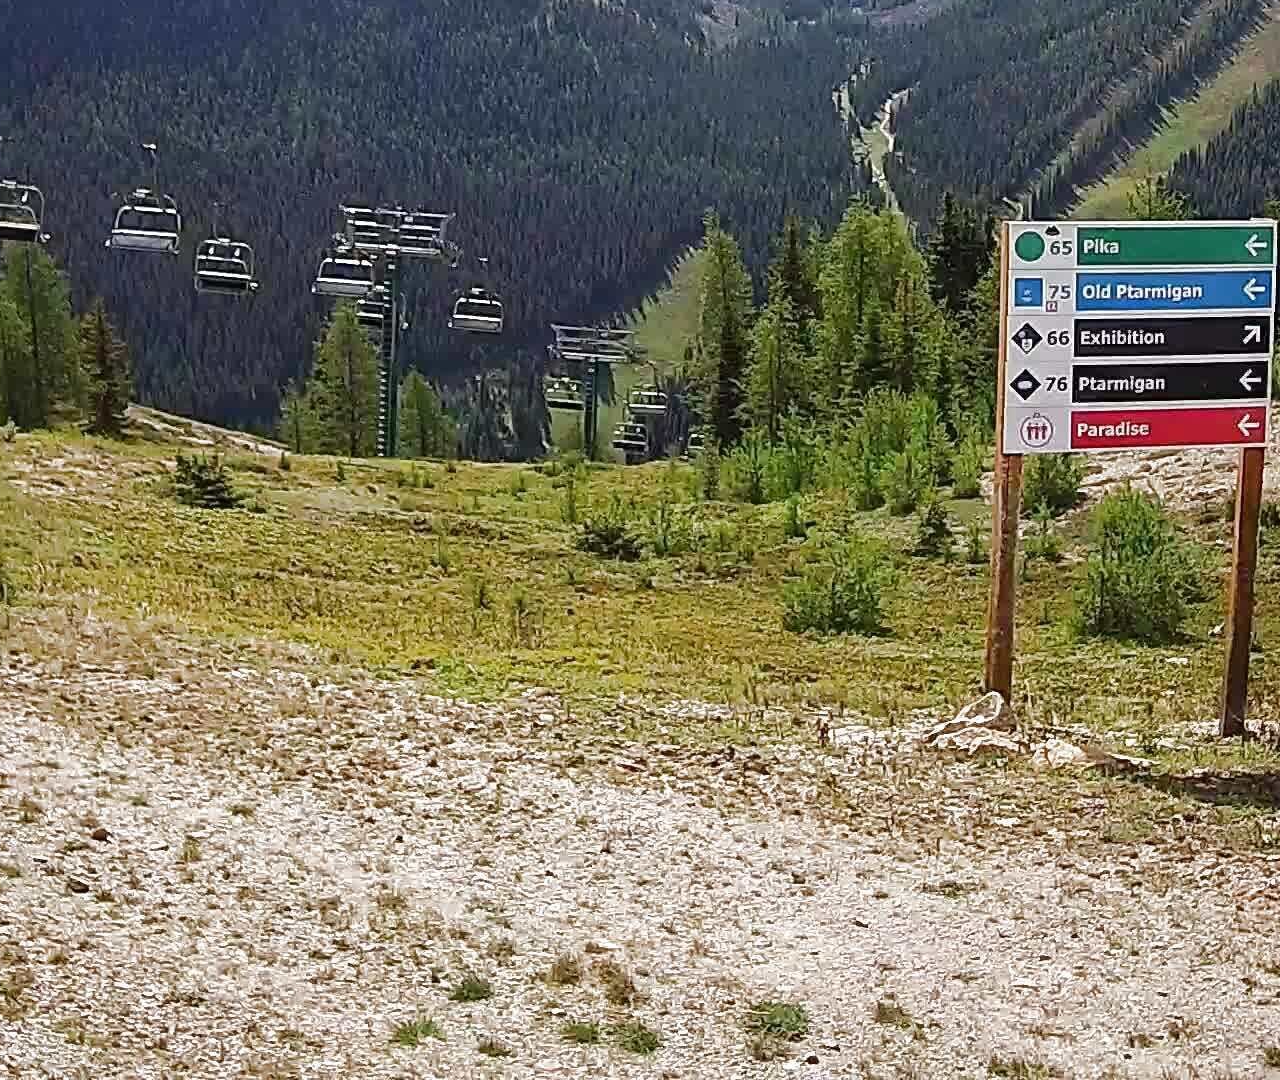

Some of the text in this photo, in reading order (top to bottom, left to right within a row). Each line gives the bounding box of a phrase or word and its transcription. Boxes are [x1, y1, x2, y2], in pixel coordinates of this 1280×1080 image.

[1049, 238, 1120, 256] 65 Pika
[1048, 283, 1203, 301] 75 Old Ptarmigan
[1047, 329, 1166, 346] 66 Exhibition
[1045, 375, 1166, 393] 76 Ptarmigan
[1077, 421, 1150, 438] Paradise
